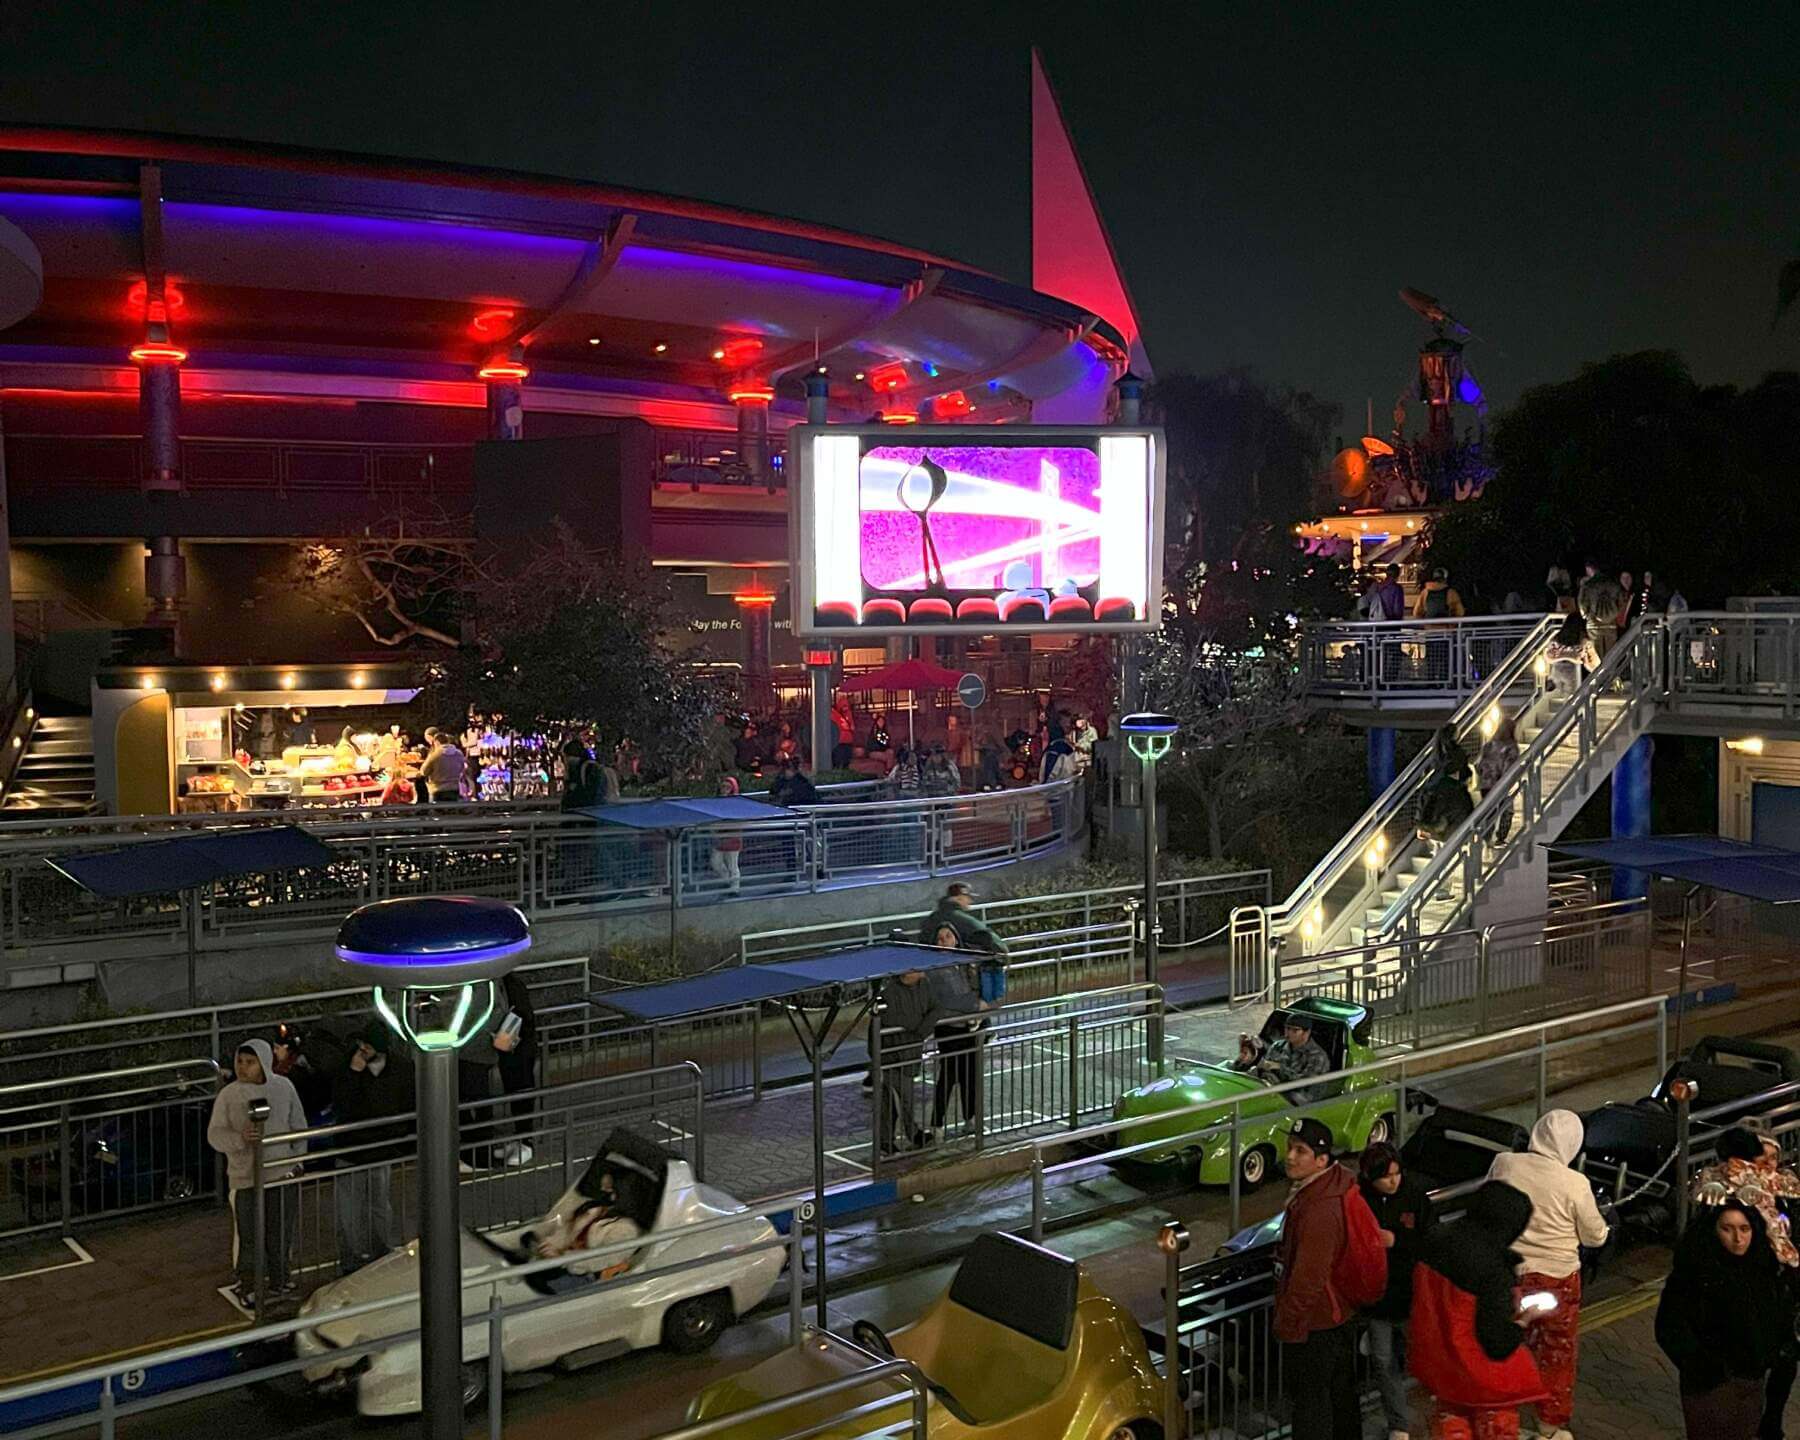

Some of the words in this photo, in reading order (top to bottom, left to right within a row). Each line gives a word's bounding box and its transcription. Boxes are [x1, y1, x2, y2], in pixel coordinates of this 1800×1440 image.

[711, 619, 728, 630] the
[1167, 1230, 1177, 1249] 6
[127, 1370, 139, 1386] 5
